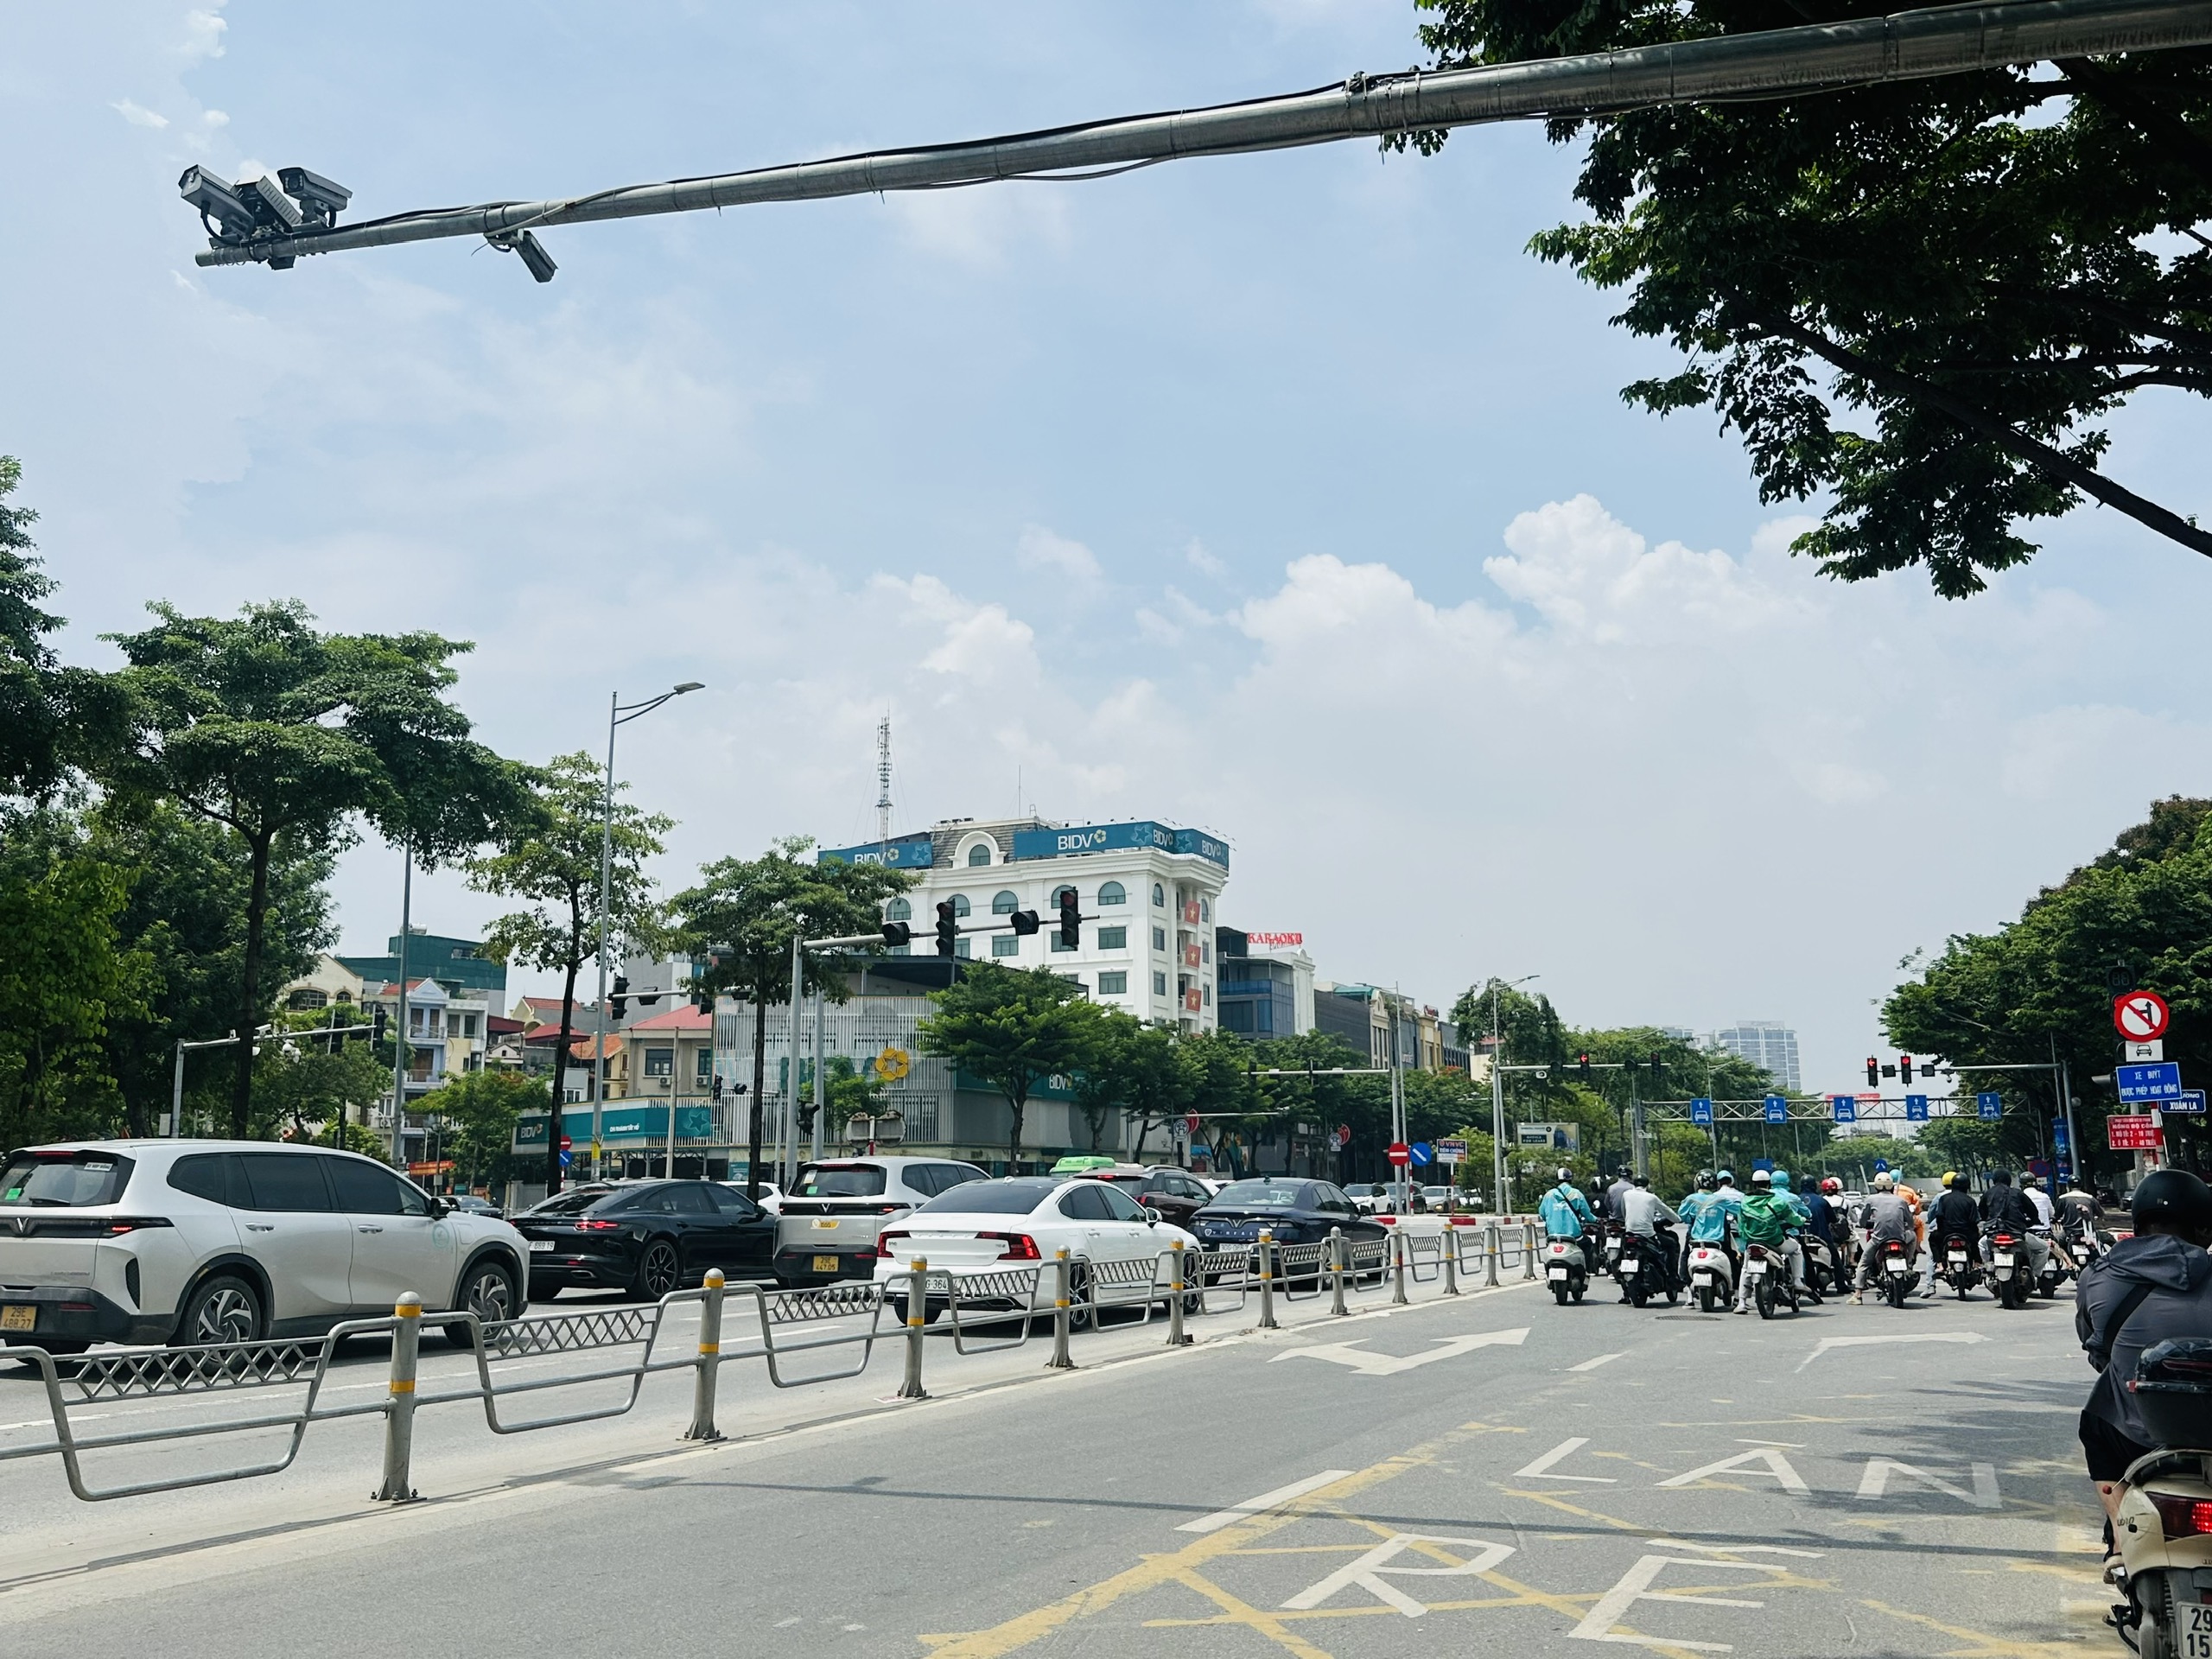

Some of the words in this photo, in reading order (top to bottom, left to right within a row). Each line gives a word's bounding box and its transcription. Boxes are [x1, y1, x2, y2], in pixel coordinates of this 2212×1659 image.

[1058, 833, 1093, 850] BIDV
[1154, 830, 1168, 847] BIDV
[1202, 840, 1217, 857] BIDV
[855, 852, 887, 865] BIDV
[1049, 1074, 1066, 1090] BIDV
[2134, 1071, 2142, 1080] XE
[2189, 1102, 2197, 1110] LA
[521, 1126, 536, 1138] BIDV
[10, 1307, 27, 1317] 29E
[1513, 1437, 2003, 1509] LÀN
[1281, 1532, 1826, 1652] RẼ
[2187, 1632, 2210, 1658] 15
